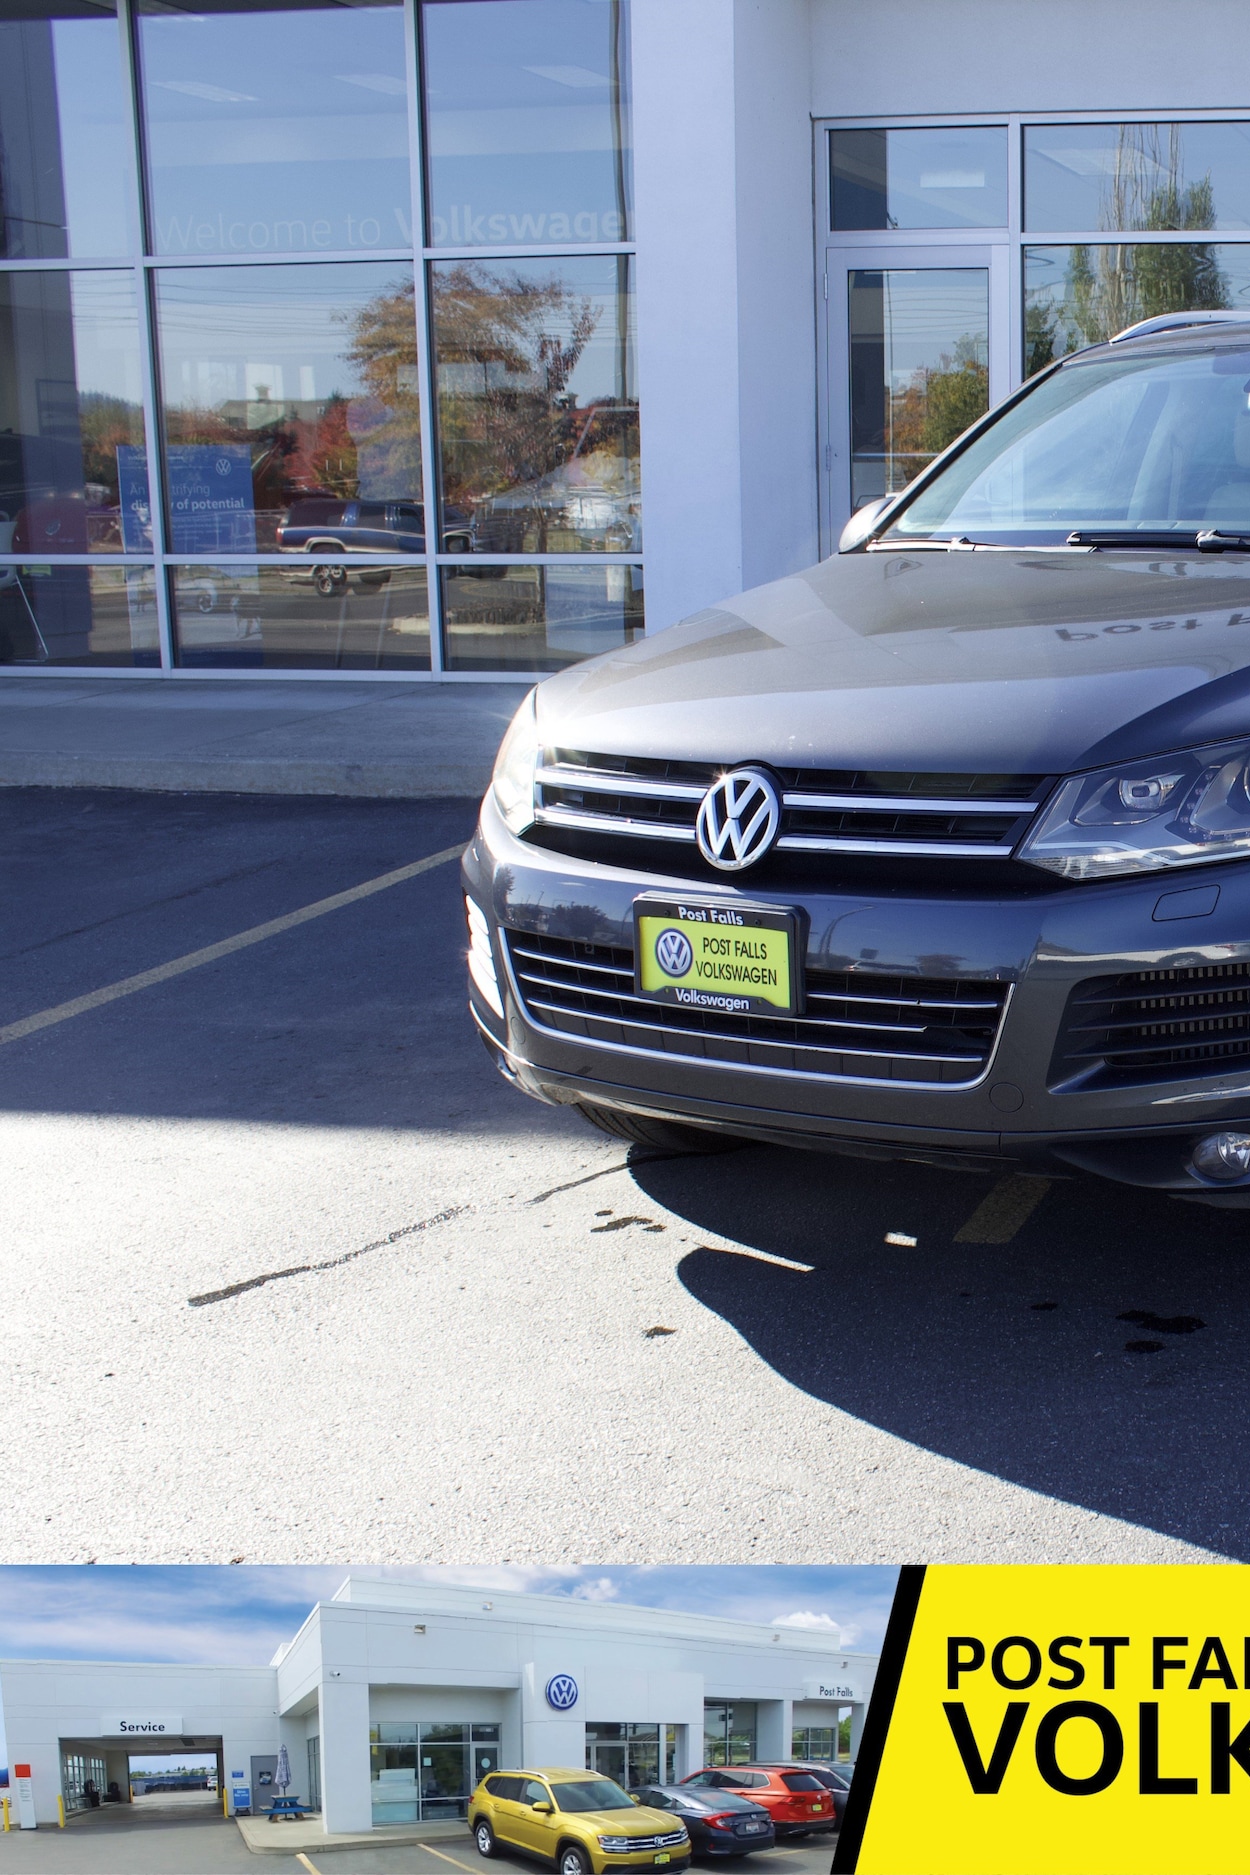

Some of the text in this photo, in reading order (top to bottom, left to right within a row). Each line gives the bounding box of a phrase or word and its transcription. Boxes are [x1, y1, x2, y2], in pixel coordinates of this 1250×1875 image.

[152, 212, 332, 251] Welcome
[344, 213, 382, 246] to
[130, 484, 146, 496] An
[176, 498, 190, 511] of
[191, 497, 246, 512] potential
[677, 906, 744, 926] Post Falls
[702, 936, 767, 960] POST FALLS
[695, 960, 778, 986] VOLKSWAGEN
[674, 987, 750, 1011] Volkswagen
